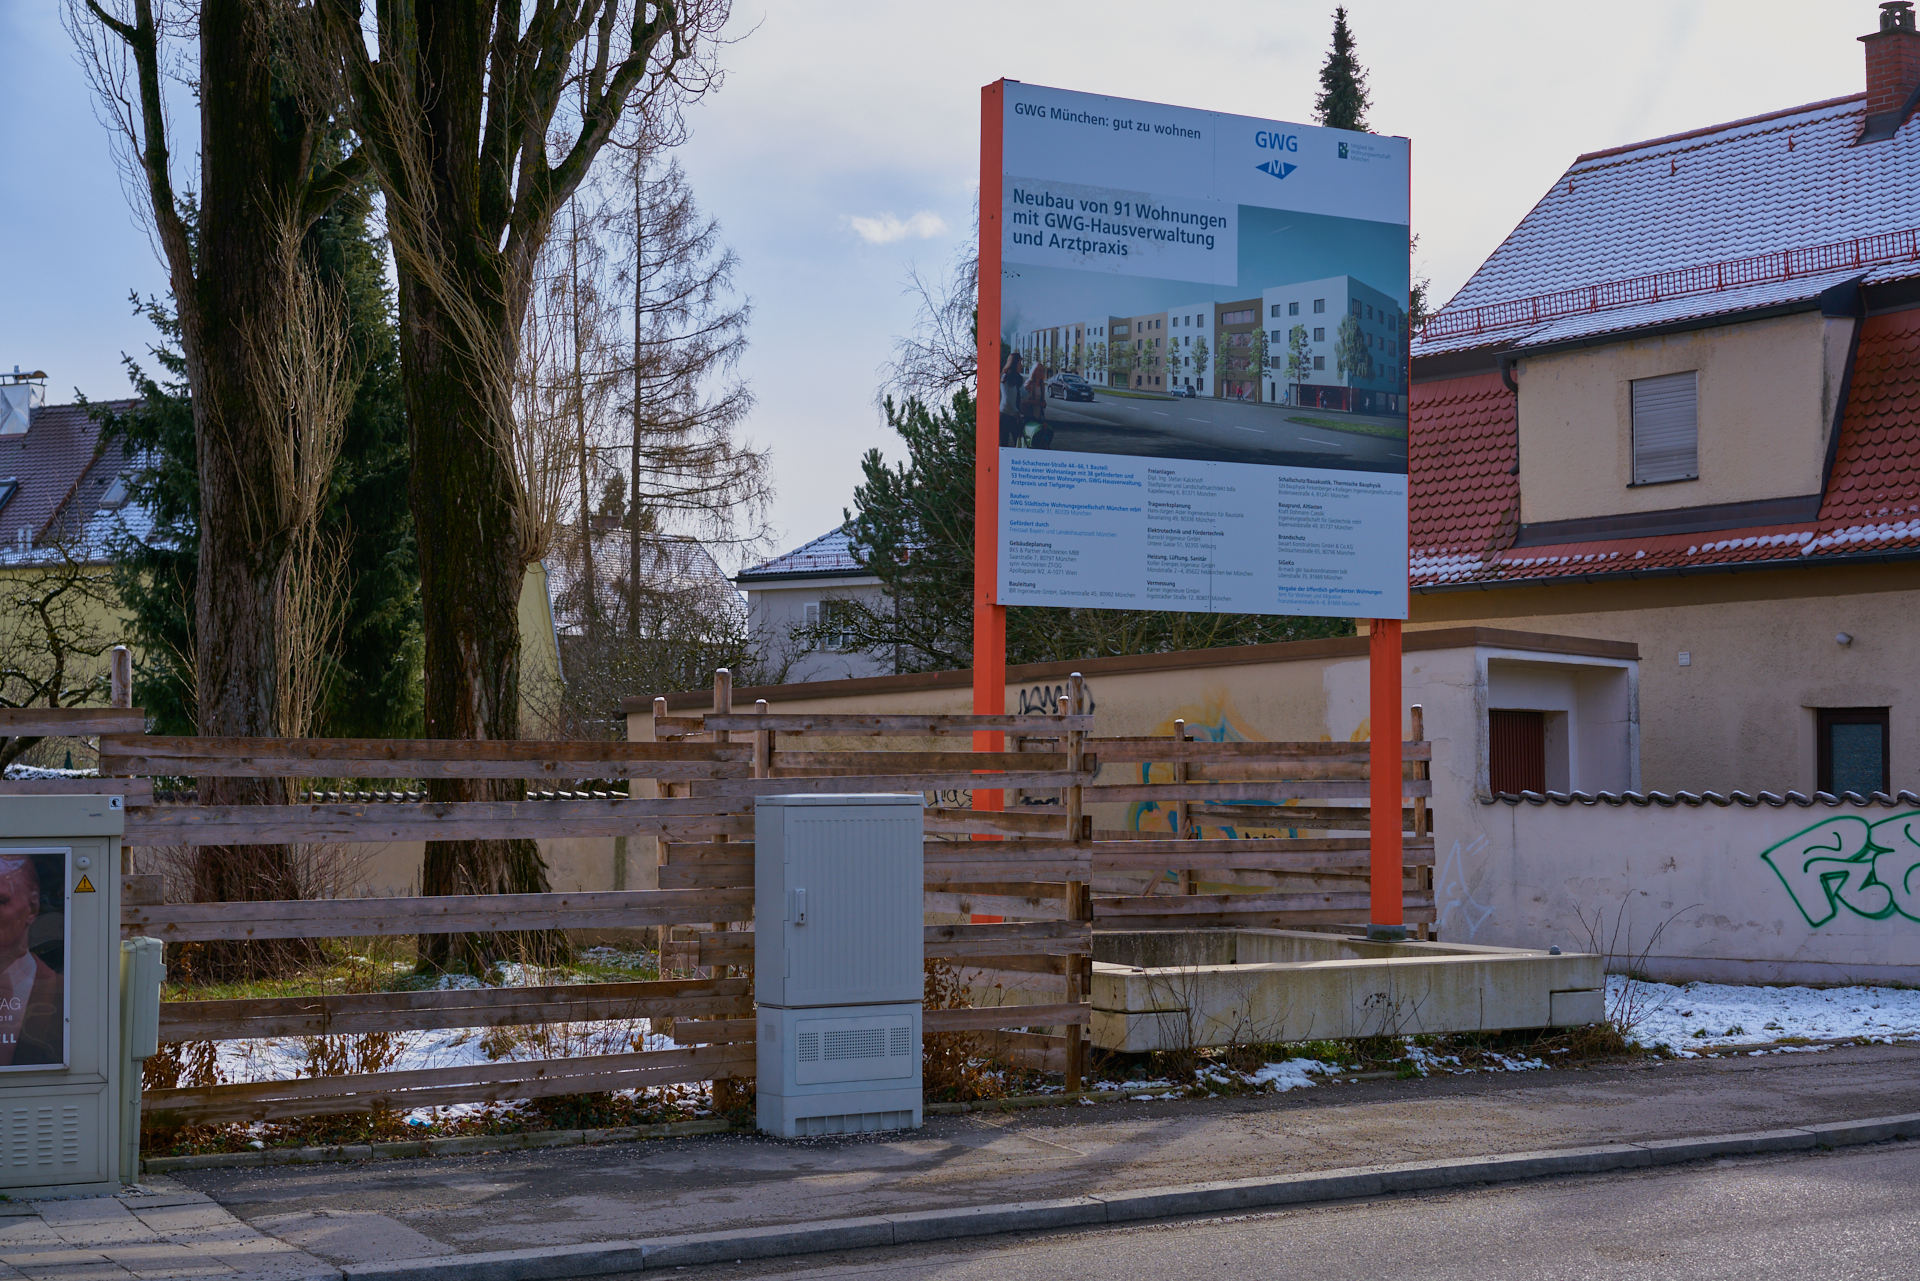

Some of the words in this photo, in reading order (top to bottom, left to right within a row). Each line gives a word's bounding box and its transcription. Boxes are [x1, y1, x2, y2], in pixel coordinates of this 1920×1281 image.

[1015, 102, 1046, 118] GWG
[1050, 106, 1109, 126] München:
[1113, 117, 1133, 133] gut
[1137, 120, 1150, 133] zu
[1154, 122, 1200, 139] wohnen
[1255, 130, 1298, 152] GWG
[1013, 188, 1074, 211] Neubau
[1080, 200, 1108, 215] von
[1114, 201, 1131, 217] 91
[1136, 203, 1227, 231] Wohnungen
[1013, 210, 1039, 226] mit
[1044, 213, 1215, 250] GWG-Hausverwaltung
[1013, 230, 1043, 246] und
[1049, 234, 1127, 256] Arztpraxis
[1046, 468, 1077, 476] Wohnanlage
[1057, 475, 1087, 483] Wohnungen,
[1050, 502, 1105, 511] Wohnungsgesellschaft
[1148, 501, 1191, 509] Tragwerksplanung
[1056, 529, 1095, 537] Landeshauptstadt
[1009, 540, 1052, 548] Gebäudeplanung
[0, 997, 21, 1010] AG
